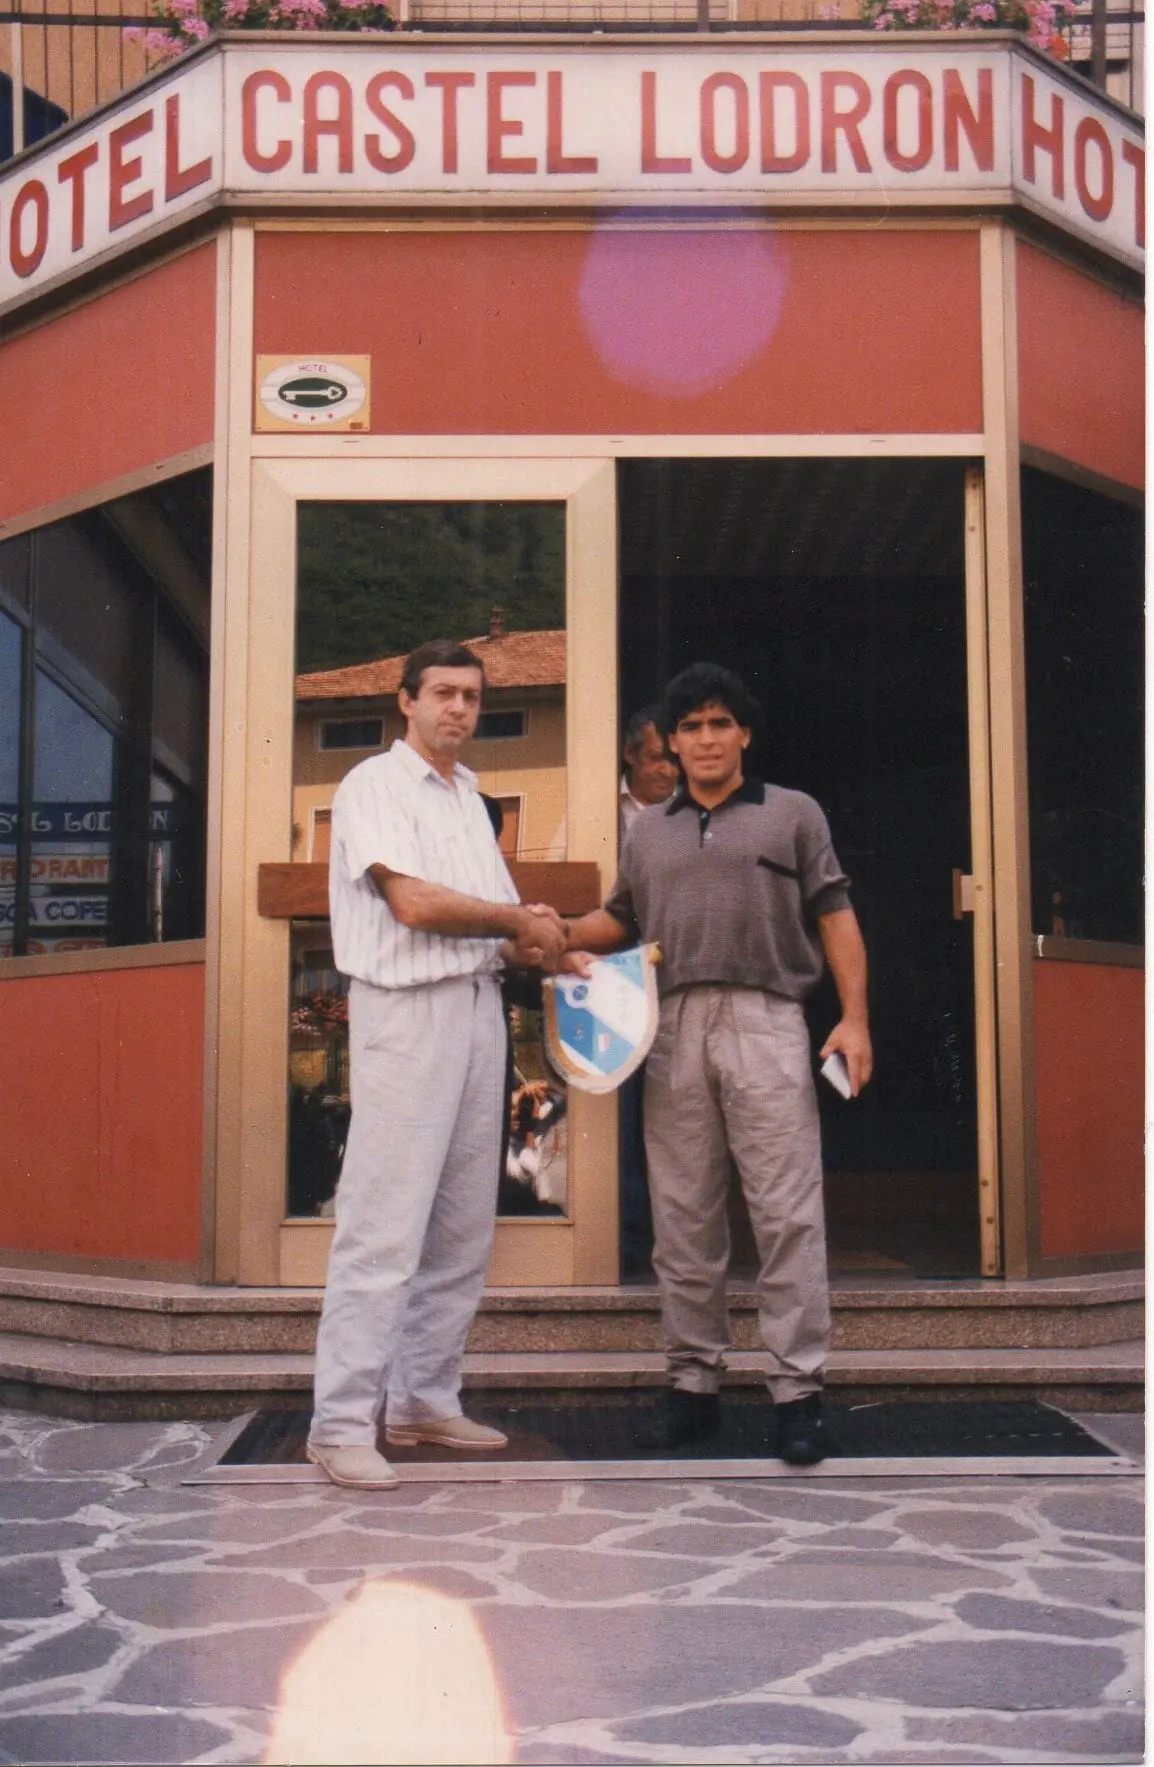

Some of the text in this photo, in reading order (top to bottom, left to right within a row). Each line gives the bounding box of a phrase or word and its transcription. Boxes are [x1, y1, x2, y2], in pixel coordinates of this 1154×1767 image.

[241, 68, 995, 174] CASTEL LODRON
[298, 364, 329, 374] HOTEL
